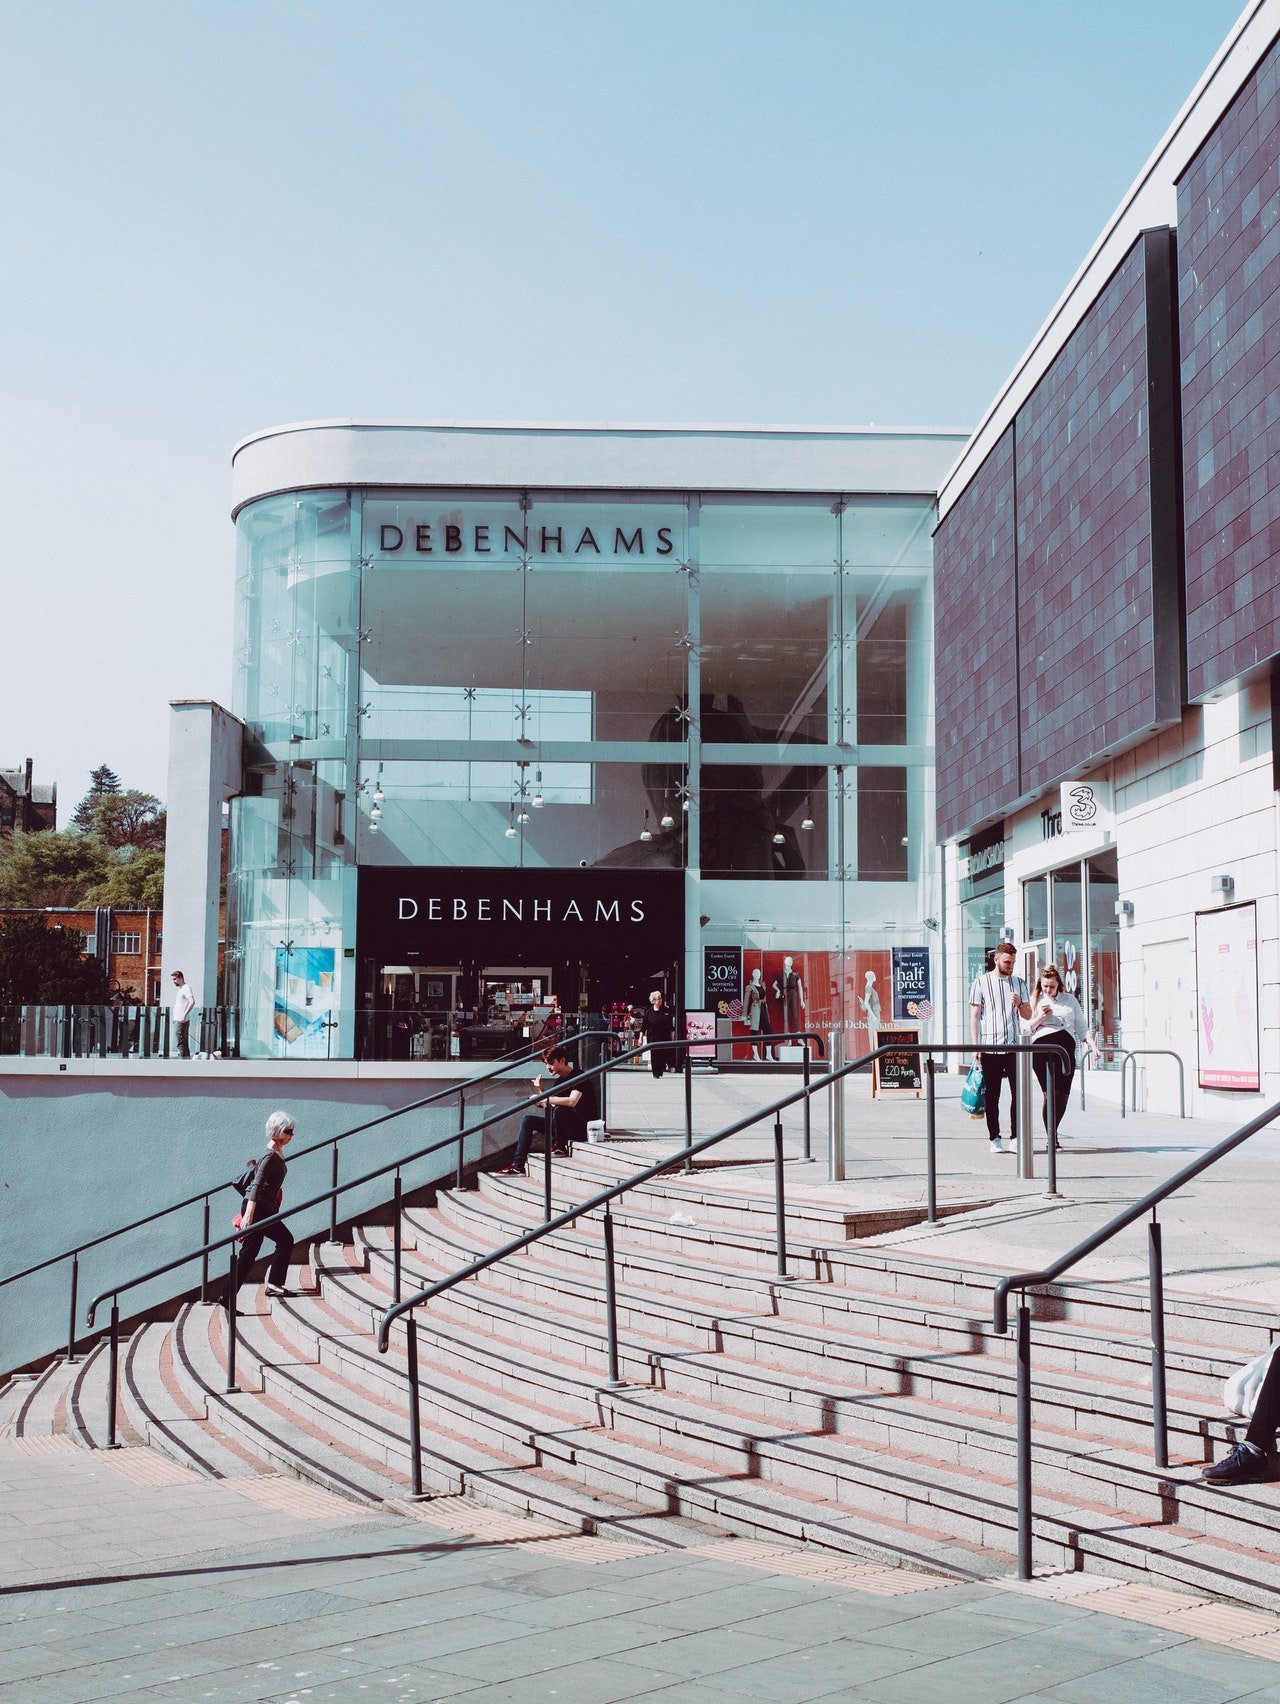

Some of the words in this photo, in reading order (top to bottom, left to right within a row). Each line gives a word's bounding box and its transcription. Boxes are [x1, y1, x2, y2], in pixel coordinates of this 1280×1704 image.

[380, 525, 673, 554] DEBENHAMS
[1070, 786, 1097, 820] 3
[1041, 808, 1062, 841] Thre
[398, 898, 645, 922] DEBENHAMS
[897, 966, 925, 980] half
[897, 980, 925, 991] price
[805, 1021, 814, 1029] do
[822, 1021, 832, 1029] bit
[833, 1021, 842, 1029] of
[885, 1065, 900, 1076] £20
